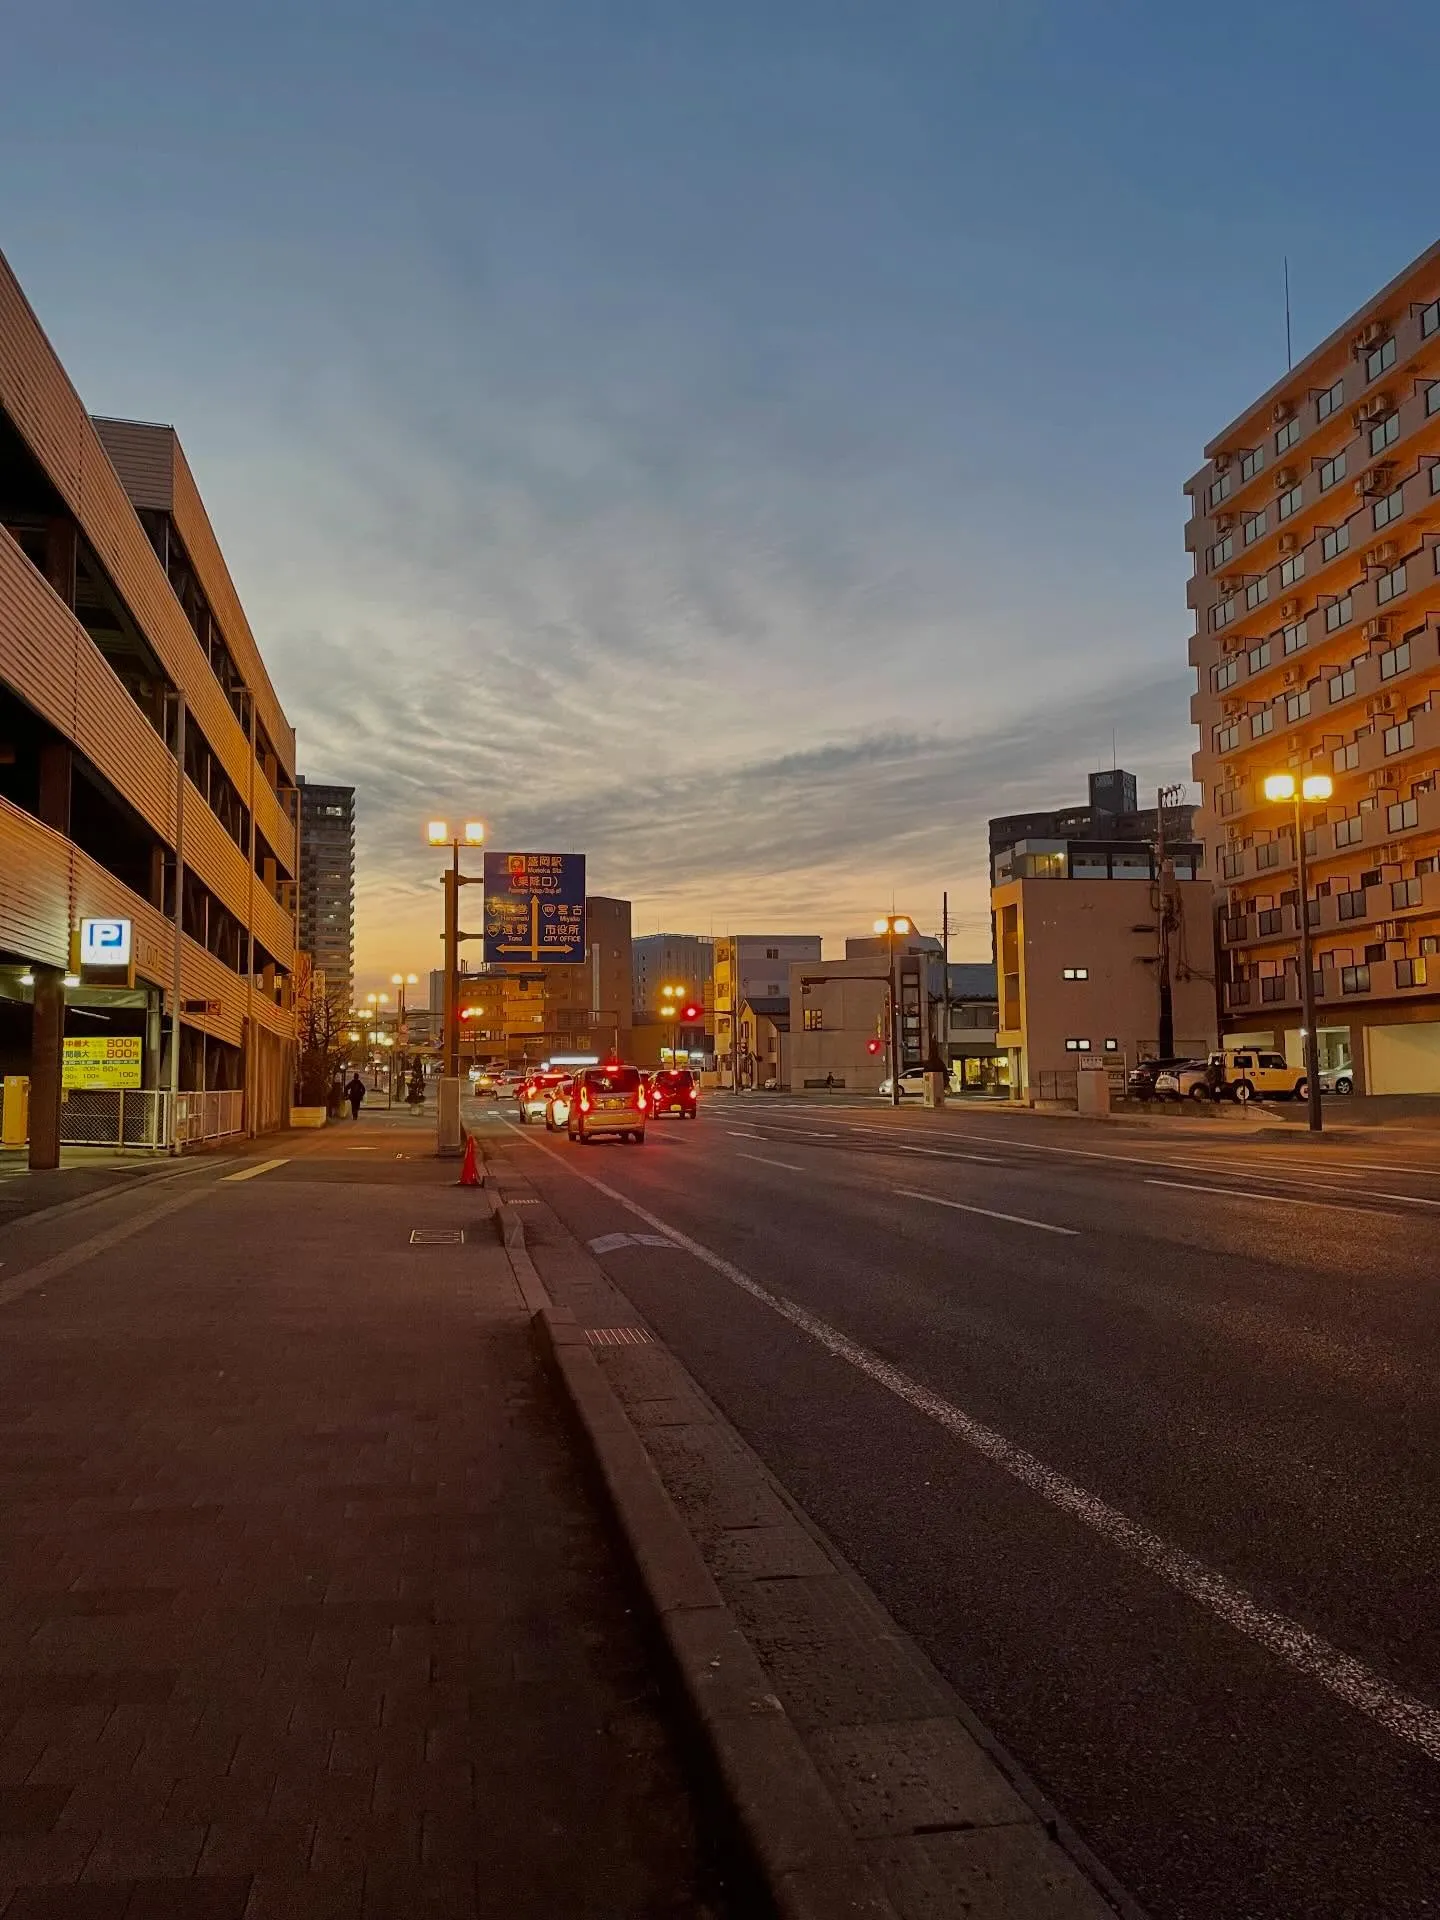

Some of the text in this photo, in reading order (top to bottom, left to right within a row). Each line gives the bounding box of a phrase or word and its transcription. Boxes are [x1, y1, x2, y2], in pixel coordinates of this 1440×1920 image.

[528, 856, 563, 867] 盛岡駅
[93, 924, 120, 946] P
[544, 925, 579, 935] 市役所
